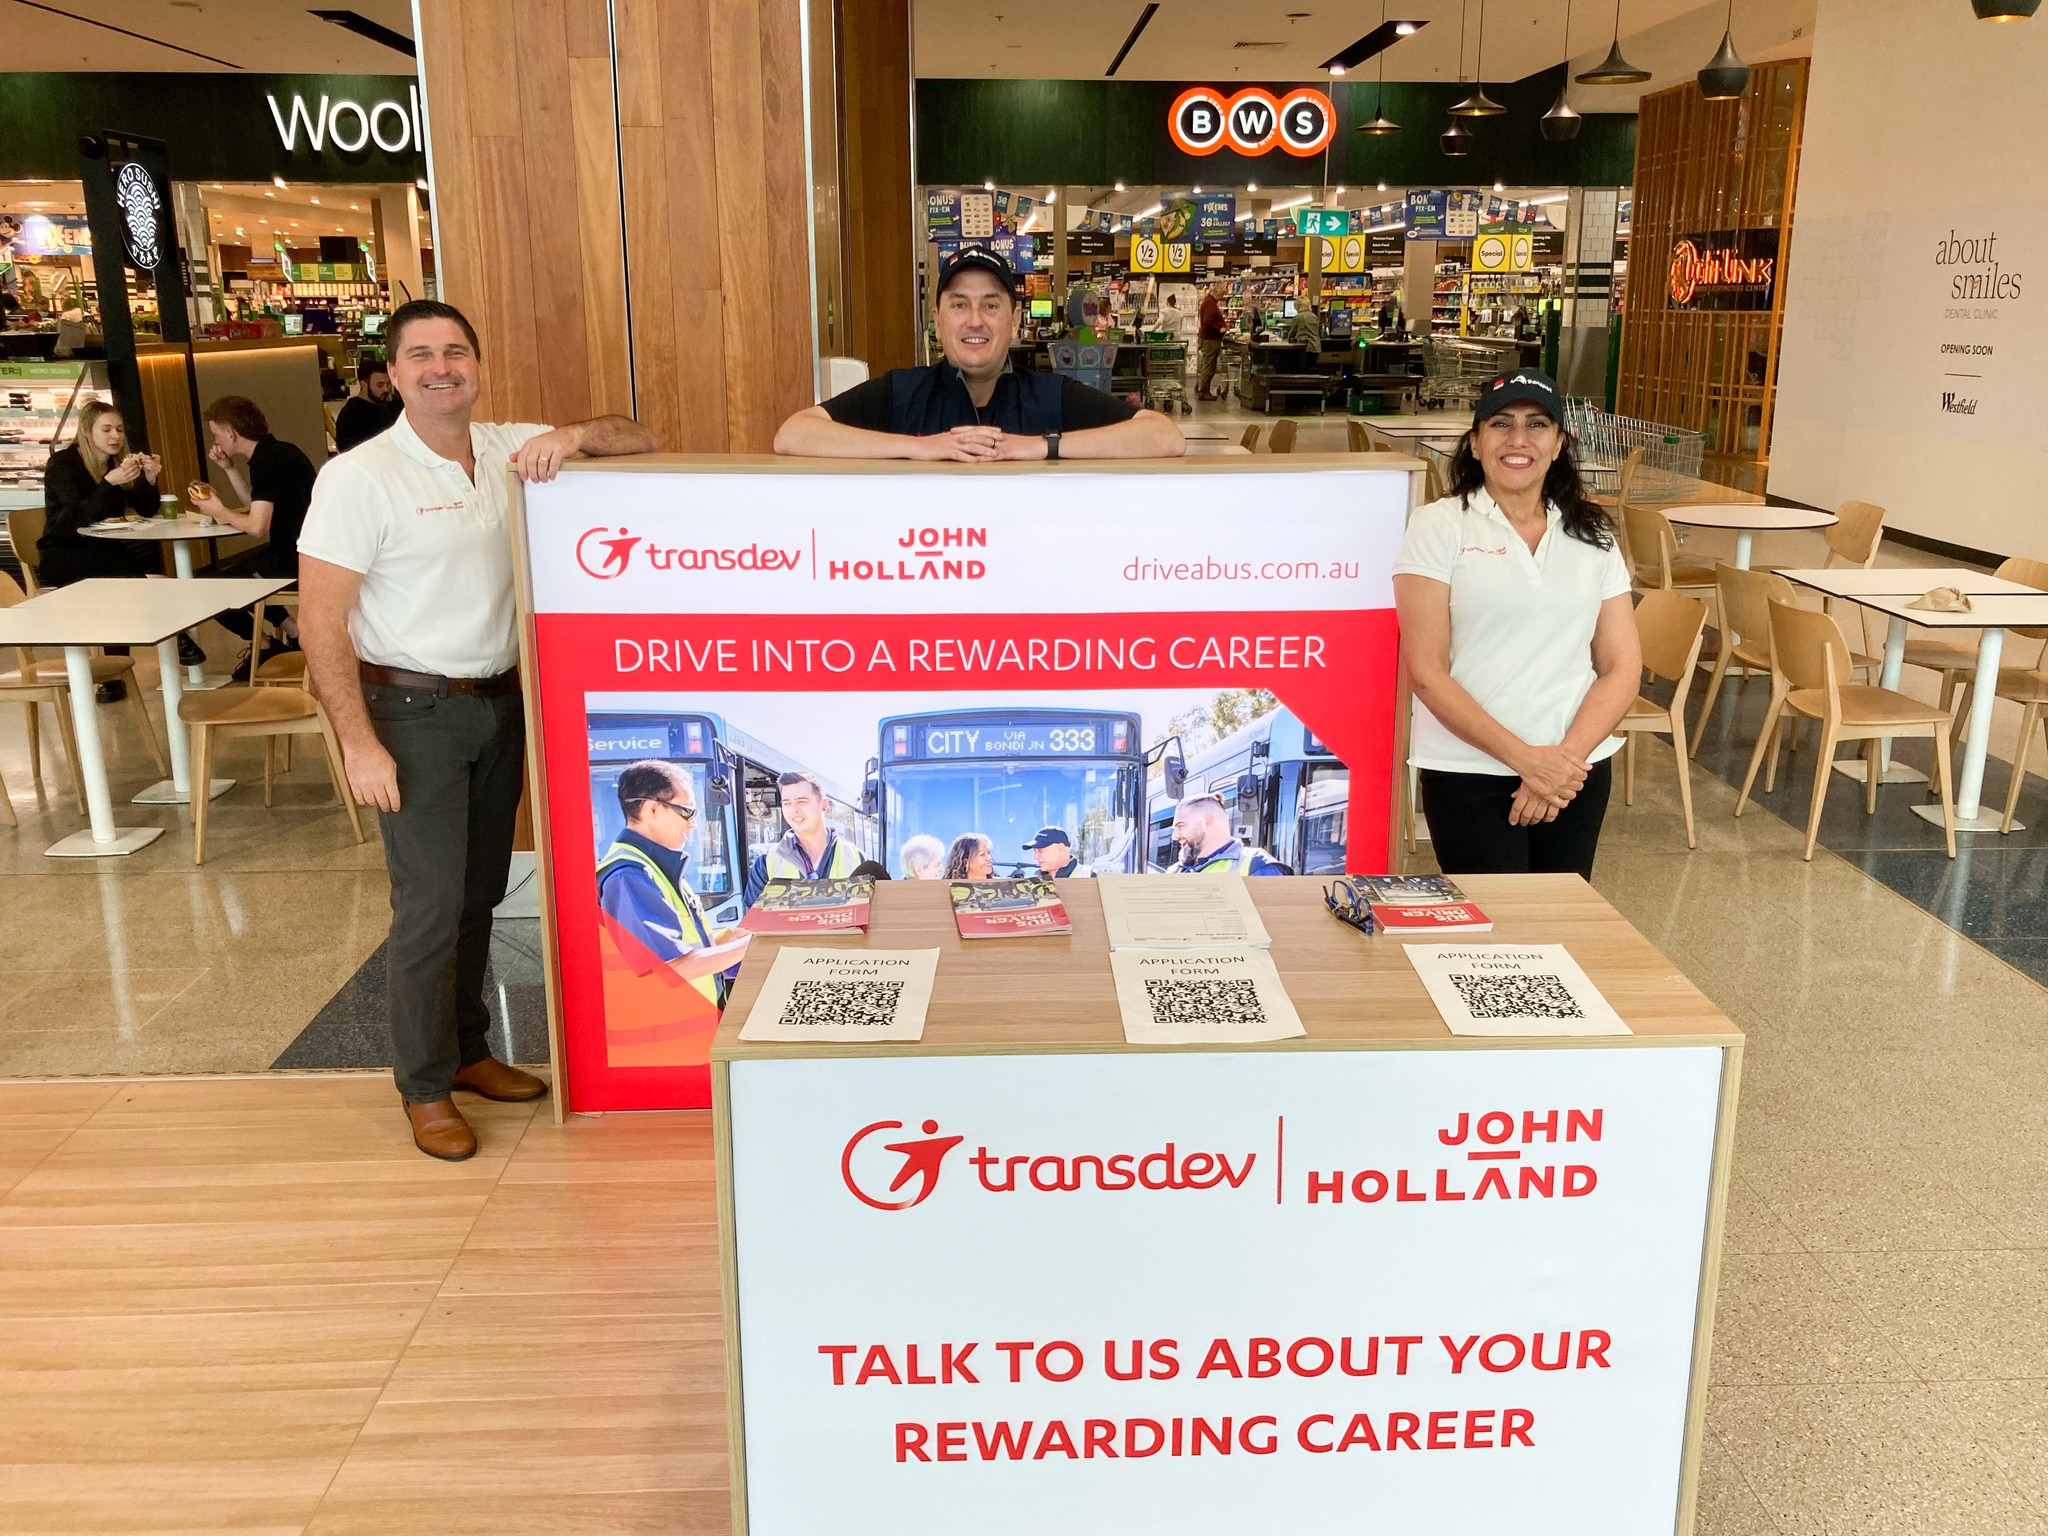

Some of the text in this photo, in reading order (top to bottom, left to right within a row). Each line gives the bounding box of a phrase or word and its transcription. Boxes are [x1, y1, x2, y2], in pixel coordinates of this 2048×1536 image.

[267, 85, 422, 152] Wool
[117, 167, 161, 210] HERO SUSHI
[928, 194, 955, 205] ONUS
[990, 239, 1015, 251] BONUS
[1141, 244, 1154, 258] 1/2
[1172, 243, 1183, 258] 1/2
[1935, 229, 1998, 265] about
[1951, 262, 2022, 300] smiles
[1944, 308, 1999, 320] DENTAL CLINIC
[1940, 343, 1994, 356] OPENING SOON
[1941, 391, 1978, 415] Westfield
[898, 527, 987, 549] JOHN
[645, 542, 801, 572] transdev
[829, 559, 986, 581] HOLLAND
[1123, 555, 1360, 582] driveabus.com.au
[614, 635, 1326, 673] DRIVE INTO A REWARDING CAREER
[927, 728, 1096, 754] CITY 333
[1003, 731, 1026, 741] VIA
[985, 741, 1045, 751] BONDI JN
[788, 912, 853, 922] DRIVER
[985, 913, 1050, 924] DRIVER
[1400, 909, 1466, 917] DRIVER
[803, 956, 910, 967] APPLICATION
[1139, 955, 1245, 966] APPLICATION
[1437, 952, 1544, 960] APPLICATION
[829, 968, 878, 976] FORM
[1170, 967, 1220, 975] FORM
[1471, 962, 1522, 970] FORM
[1437, 1108, 1604, 1146] JOHN
[968, 1142, 1257, 1193] transdev
[1307, 1164, 1598, 1205] HOLLAND
[817, 1328, 1612, 1386] TALK TO US ABOUT YOUR
[895, 1407, 1535, 1463] REWARDING CAREER
